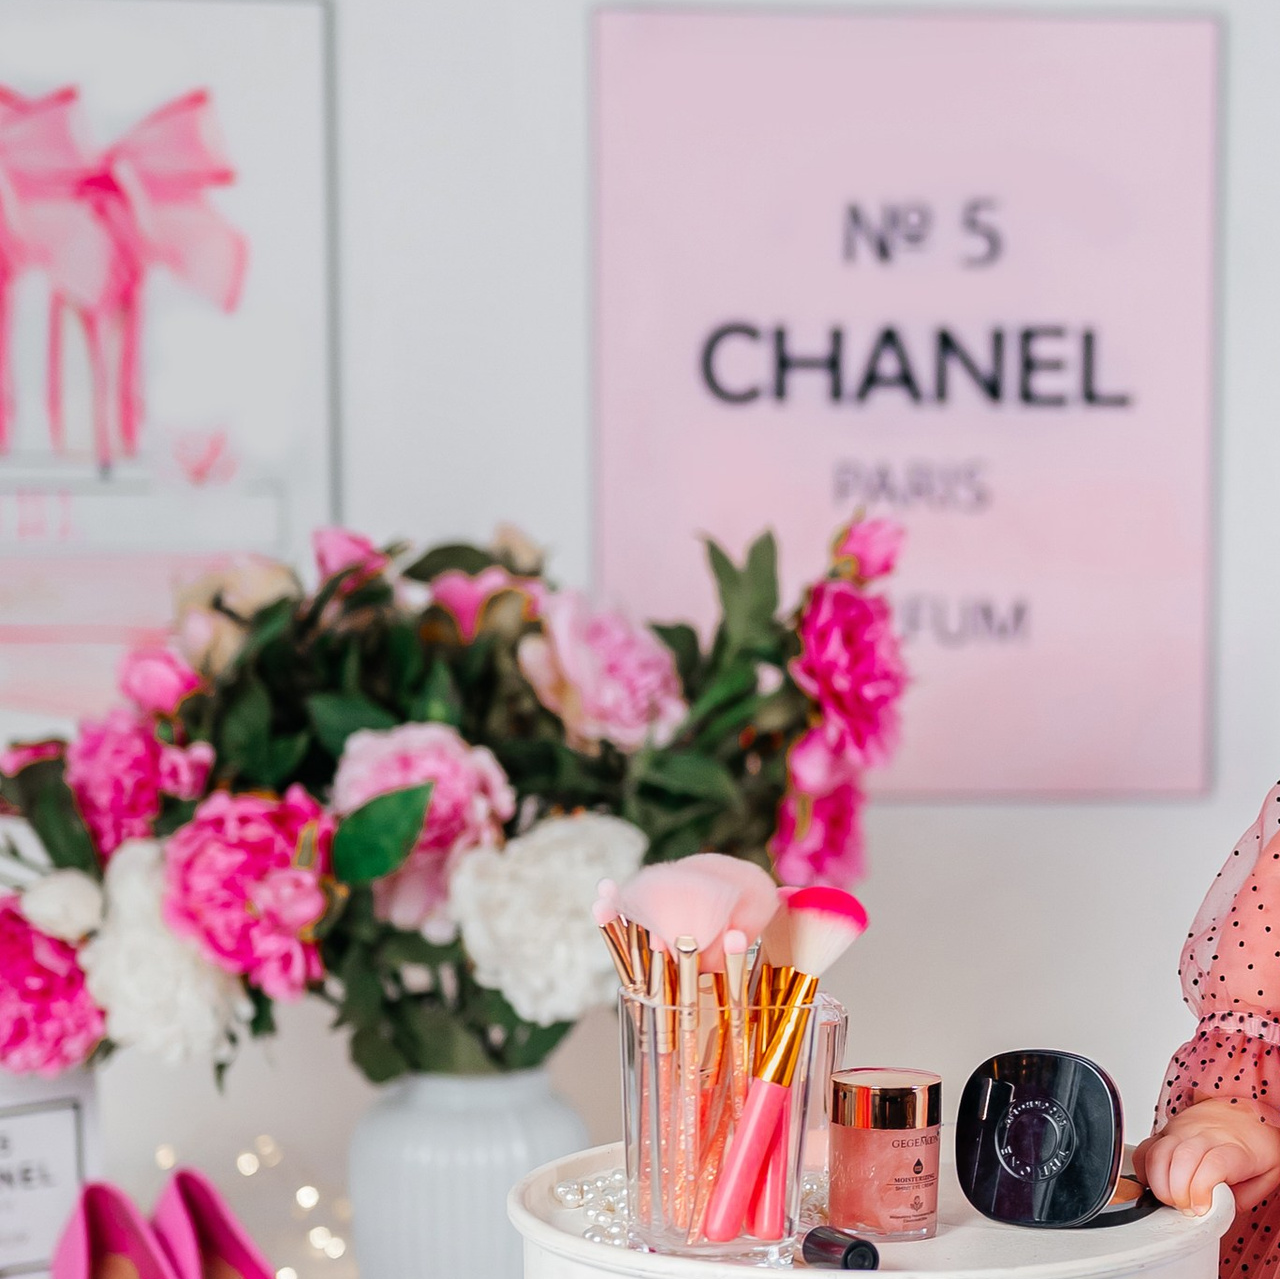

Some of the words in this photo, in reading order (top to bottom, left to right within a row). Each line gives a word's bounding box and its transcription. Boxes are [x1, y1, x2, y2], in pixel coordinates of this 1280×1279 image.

[958, 198, 1006, 269] 5
[699, 322, 1134, 409] CHANEL
[831, 463, 992, 513] PARIS
[904, 595, 1031, 648] FUM
